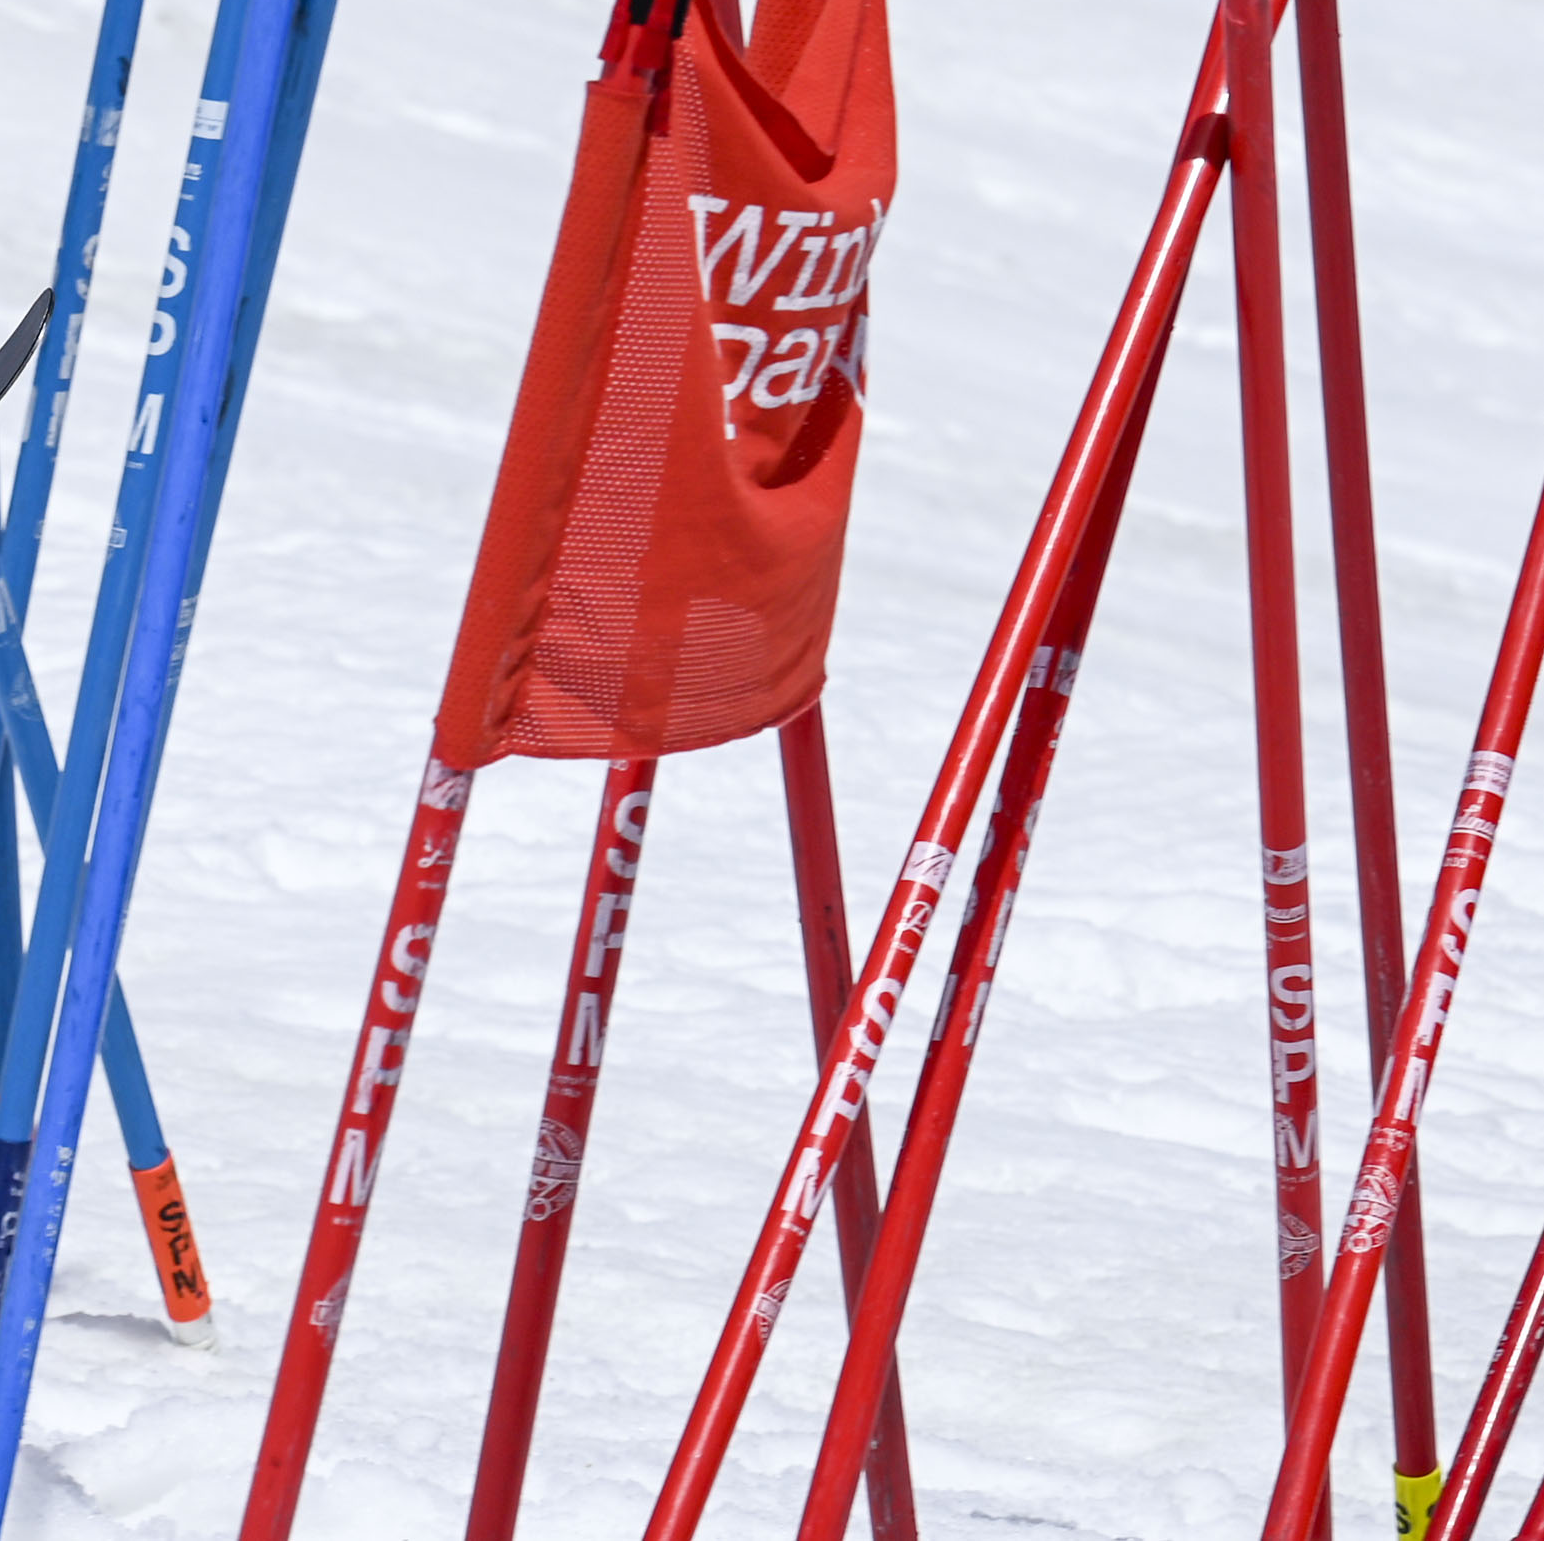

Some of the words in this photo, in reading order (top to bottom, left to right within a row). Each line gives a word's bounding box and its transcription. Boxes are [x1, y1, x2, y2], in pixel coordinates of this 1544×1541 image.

[328, 923, 435, 1208] SPM
[780, 974, 904, 1221] SPM
[1269, 963, 1318, 1169] SPM
